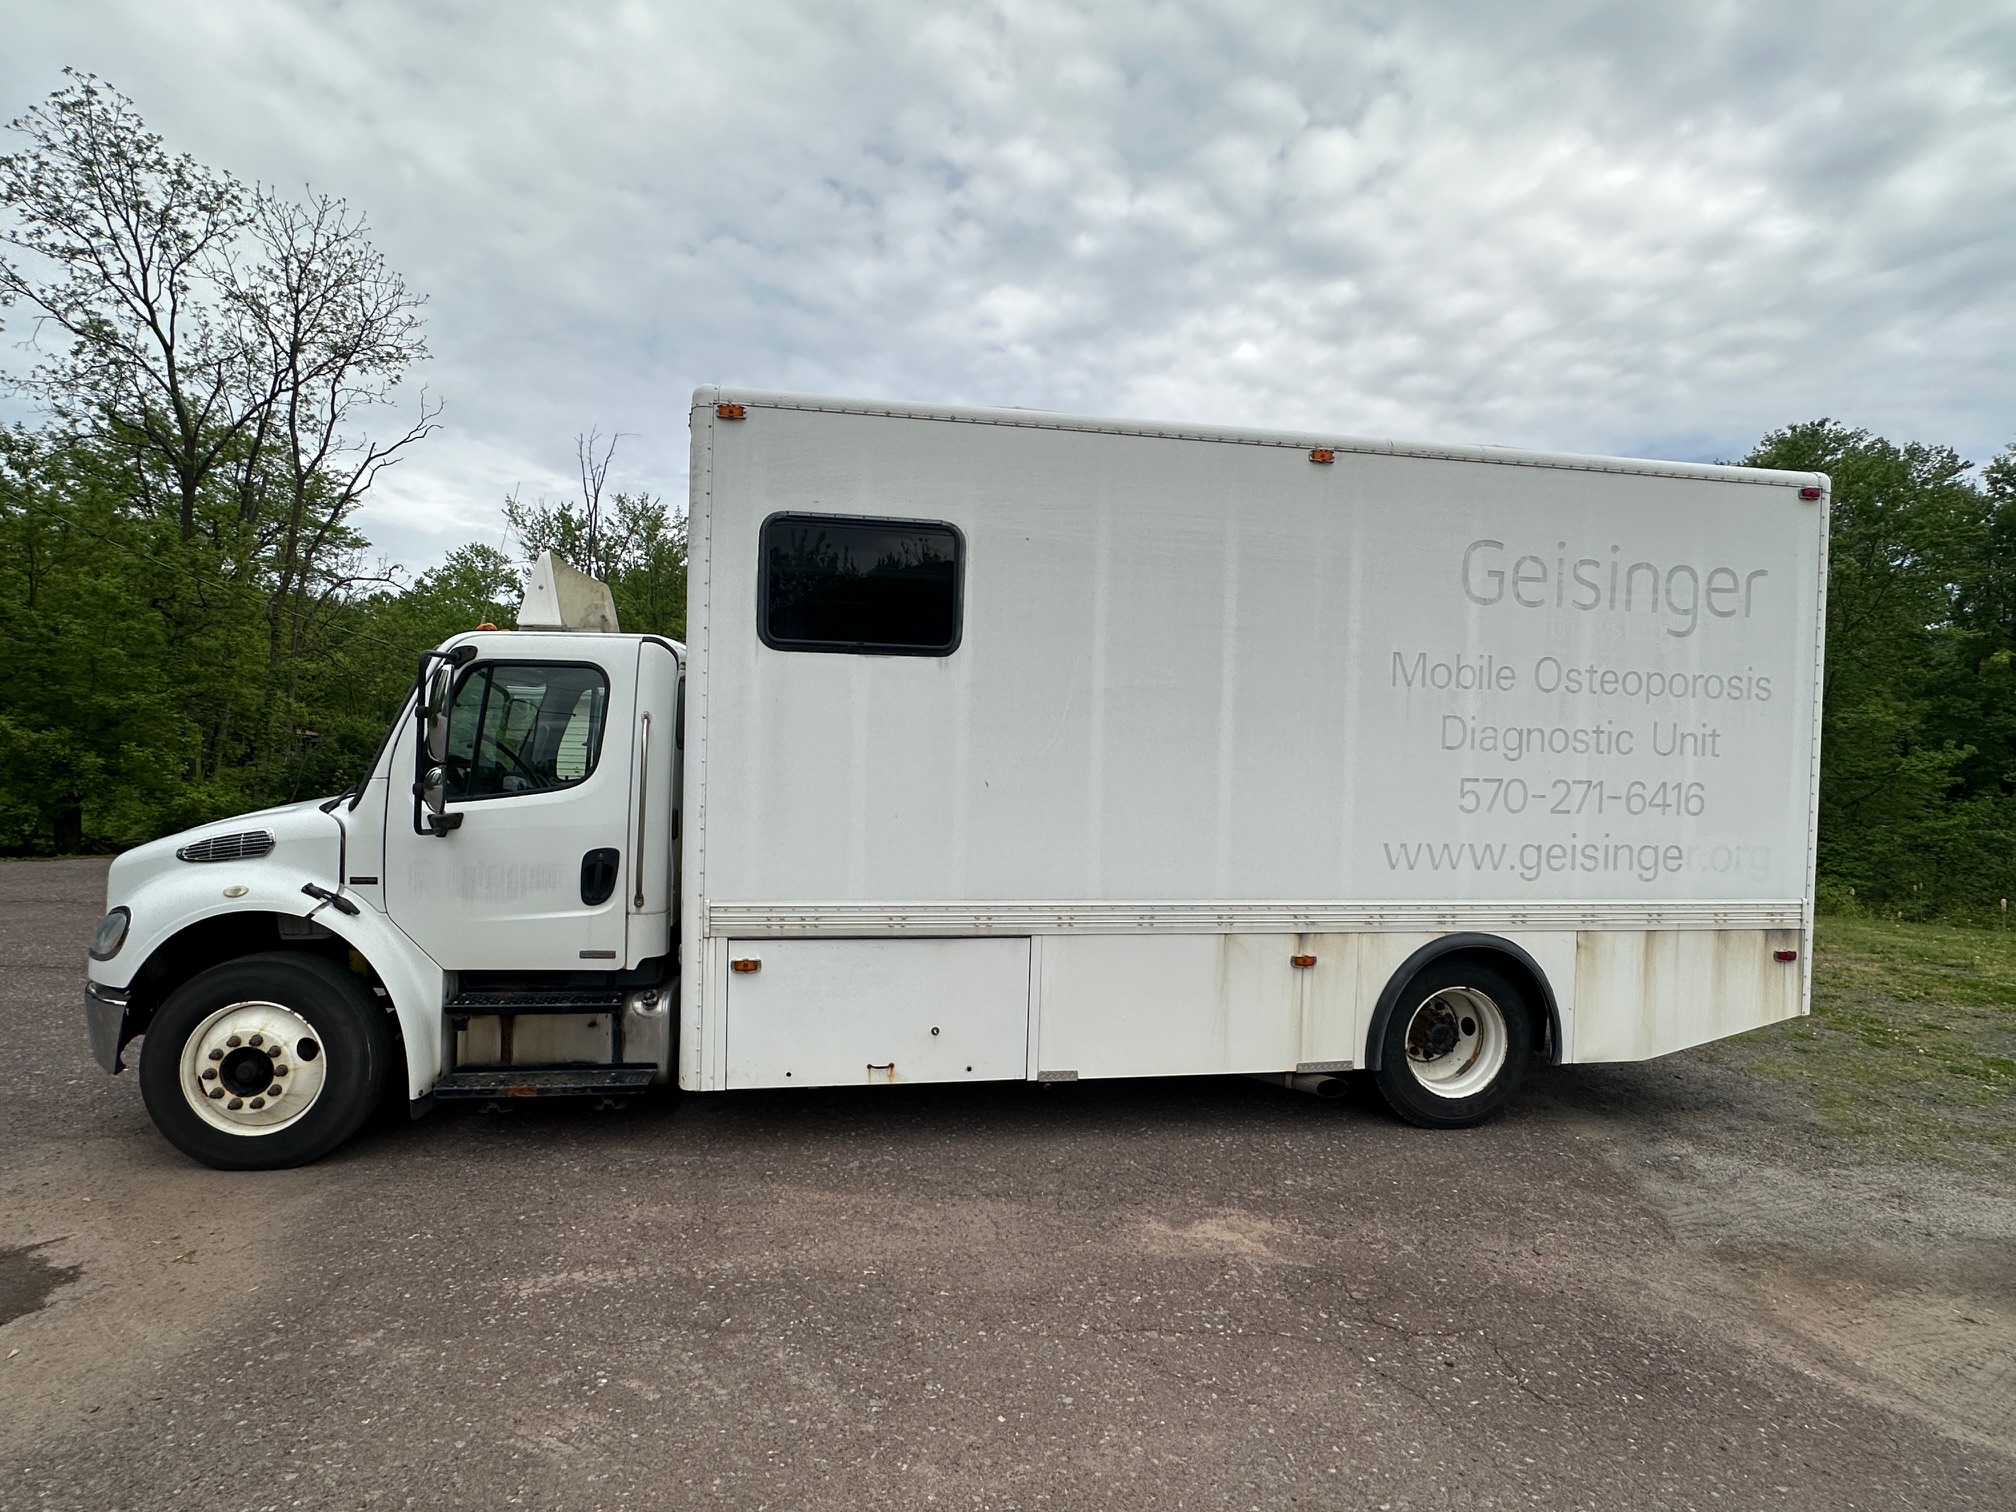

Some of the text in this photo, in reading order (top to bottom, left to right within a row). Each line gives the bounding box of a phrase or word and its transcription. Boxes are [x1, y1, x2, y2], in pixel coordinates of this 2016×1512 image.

[1461, 539, 1769, 638] Geisinger
[1391, 651, 1773, 705] Mobile Osteoporosis
[1441, 714, 1721, 761] Diagnostic Unit
[1458, 777, 1705, 816] 570-271-6416
[1383, 833, 1770, 883] www.geisinger.org
